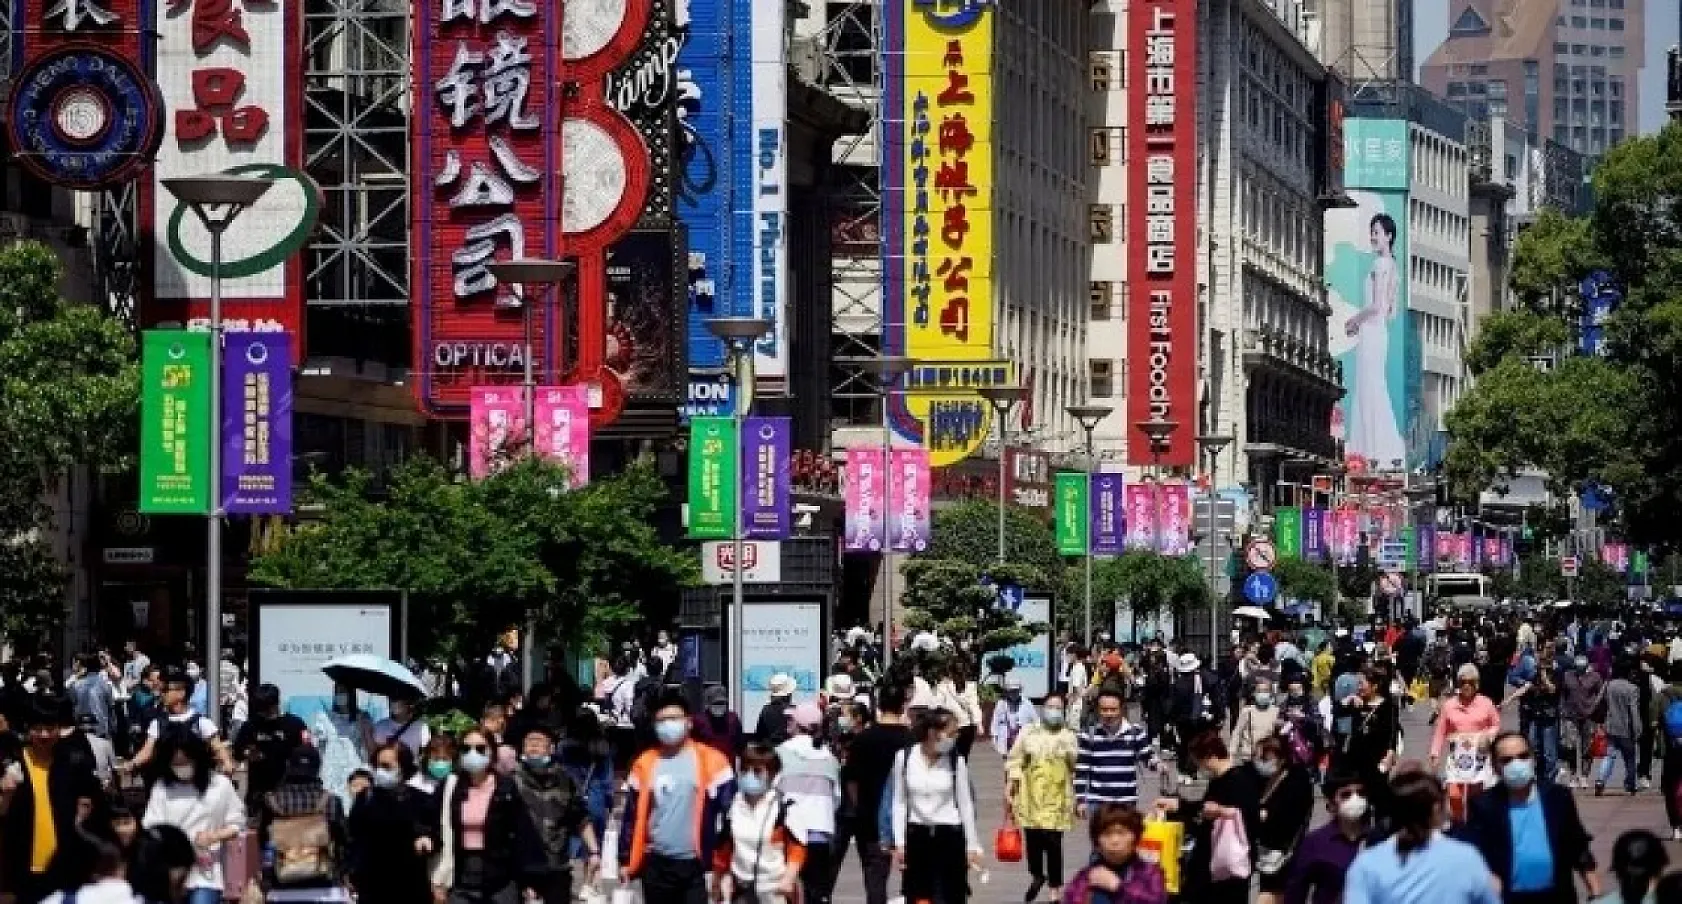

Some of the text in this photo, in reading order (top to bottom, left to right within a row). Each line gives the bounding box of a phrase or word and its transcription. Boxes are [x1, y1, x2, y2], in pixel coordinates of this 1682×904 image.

[1145, 6, 1176, 272] 上海市第一食品商店
[757, 212, 781, 359] Pharmay
[1150, 289, 1173, 335] First
